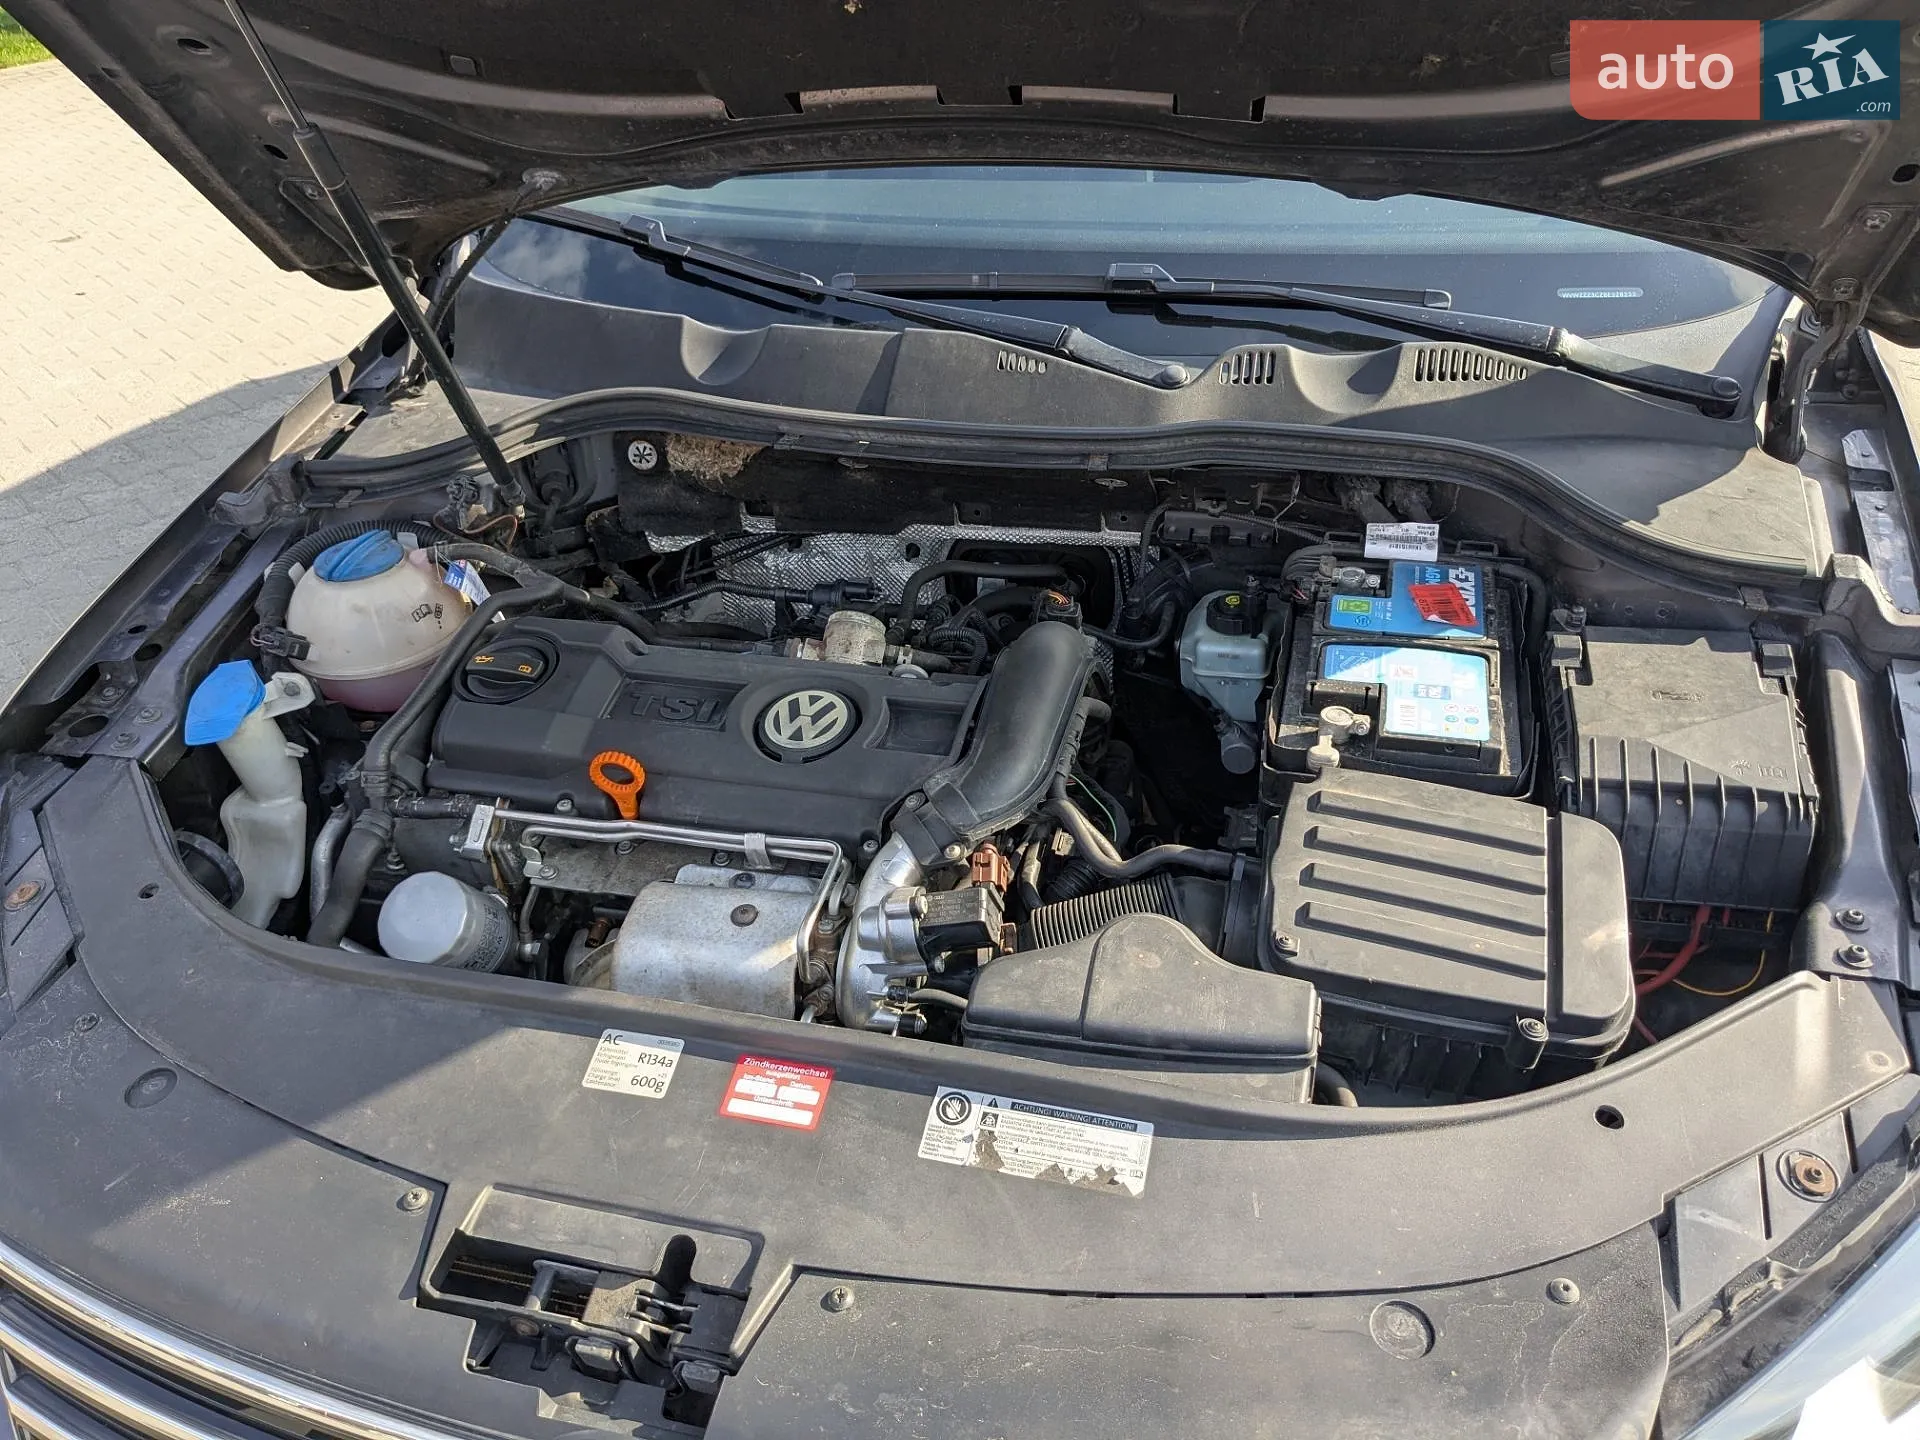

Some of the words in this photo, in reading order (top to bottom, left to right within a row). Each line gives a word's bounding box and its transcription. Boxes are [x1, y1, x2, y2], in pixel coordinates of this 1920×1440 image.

[1449, 567, 1476, 616] EXI
[631, 693, 719, 723] TSI
[769, 691, 845, 747] VW
[602, 1033, 624, 1046] AC
[638, 1052, 674, 1068] R134a
[743, 1057, 829, 1078] Zündkerzenwechsel
[630, 1074, 665, 1094] 600g
[1013, 1103, 1052, 1116] ACHTUNG!
[1053, 1109, 1091, 1123] WARNING!
[1091, 1117, 1136, 1131] ATTENTION!
